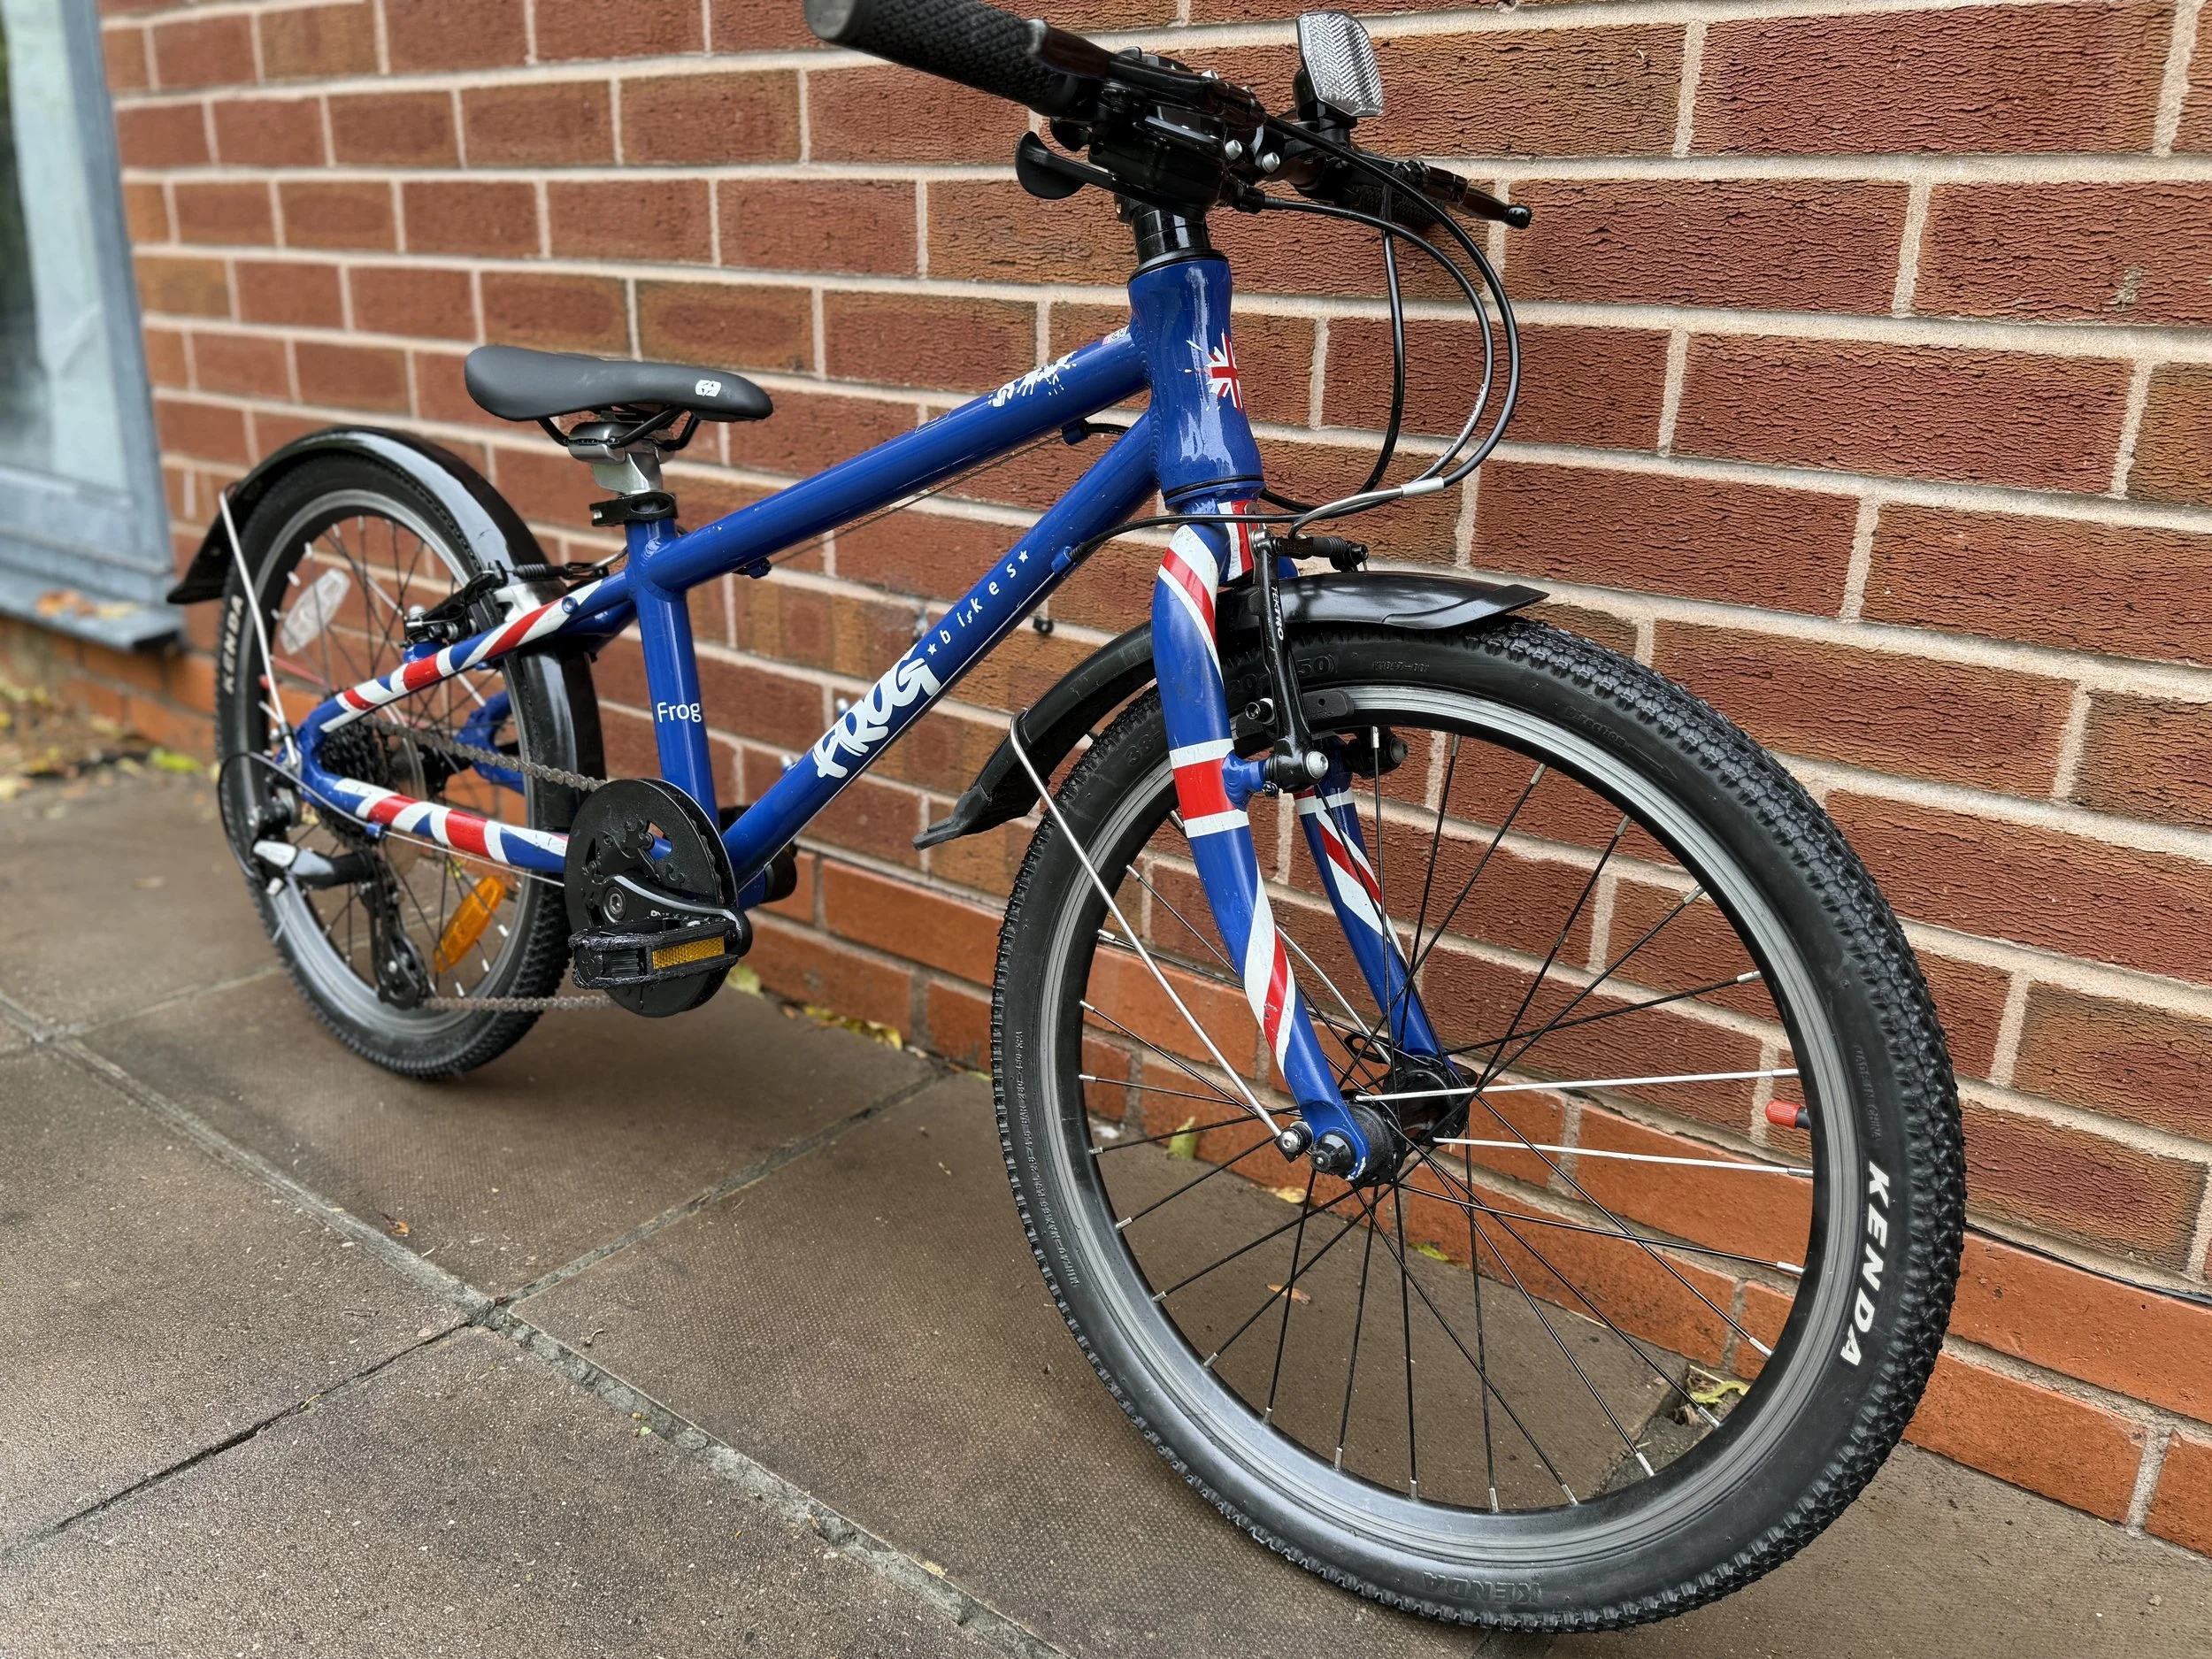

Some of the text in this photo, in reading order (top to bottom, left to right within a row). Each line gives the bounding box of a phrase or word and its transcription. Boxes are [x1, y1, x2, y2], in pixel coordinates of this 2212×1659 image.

[1271, 586, 1284, 641] TEKTRO
[223, 595, 243, 695] KENDA
[812, 563, 1017, 779] FROG bikes
[657, 702, 703, 723] Frog
[1851, 1044, 1871, 1081] MADE
[1840, 1161, 1890, 1366] KENDA
[1422, 1571, 1542, 1604] KENDA
